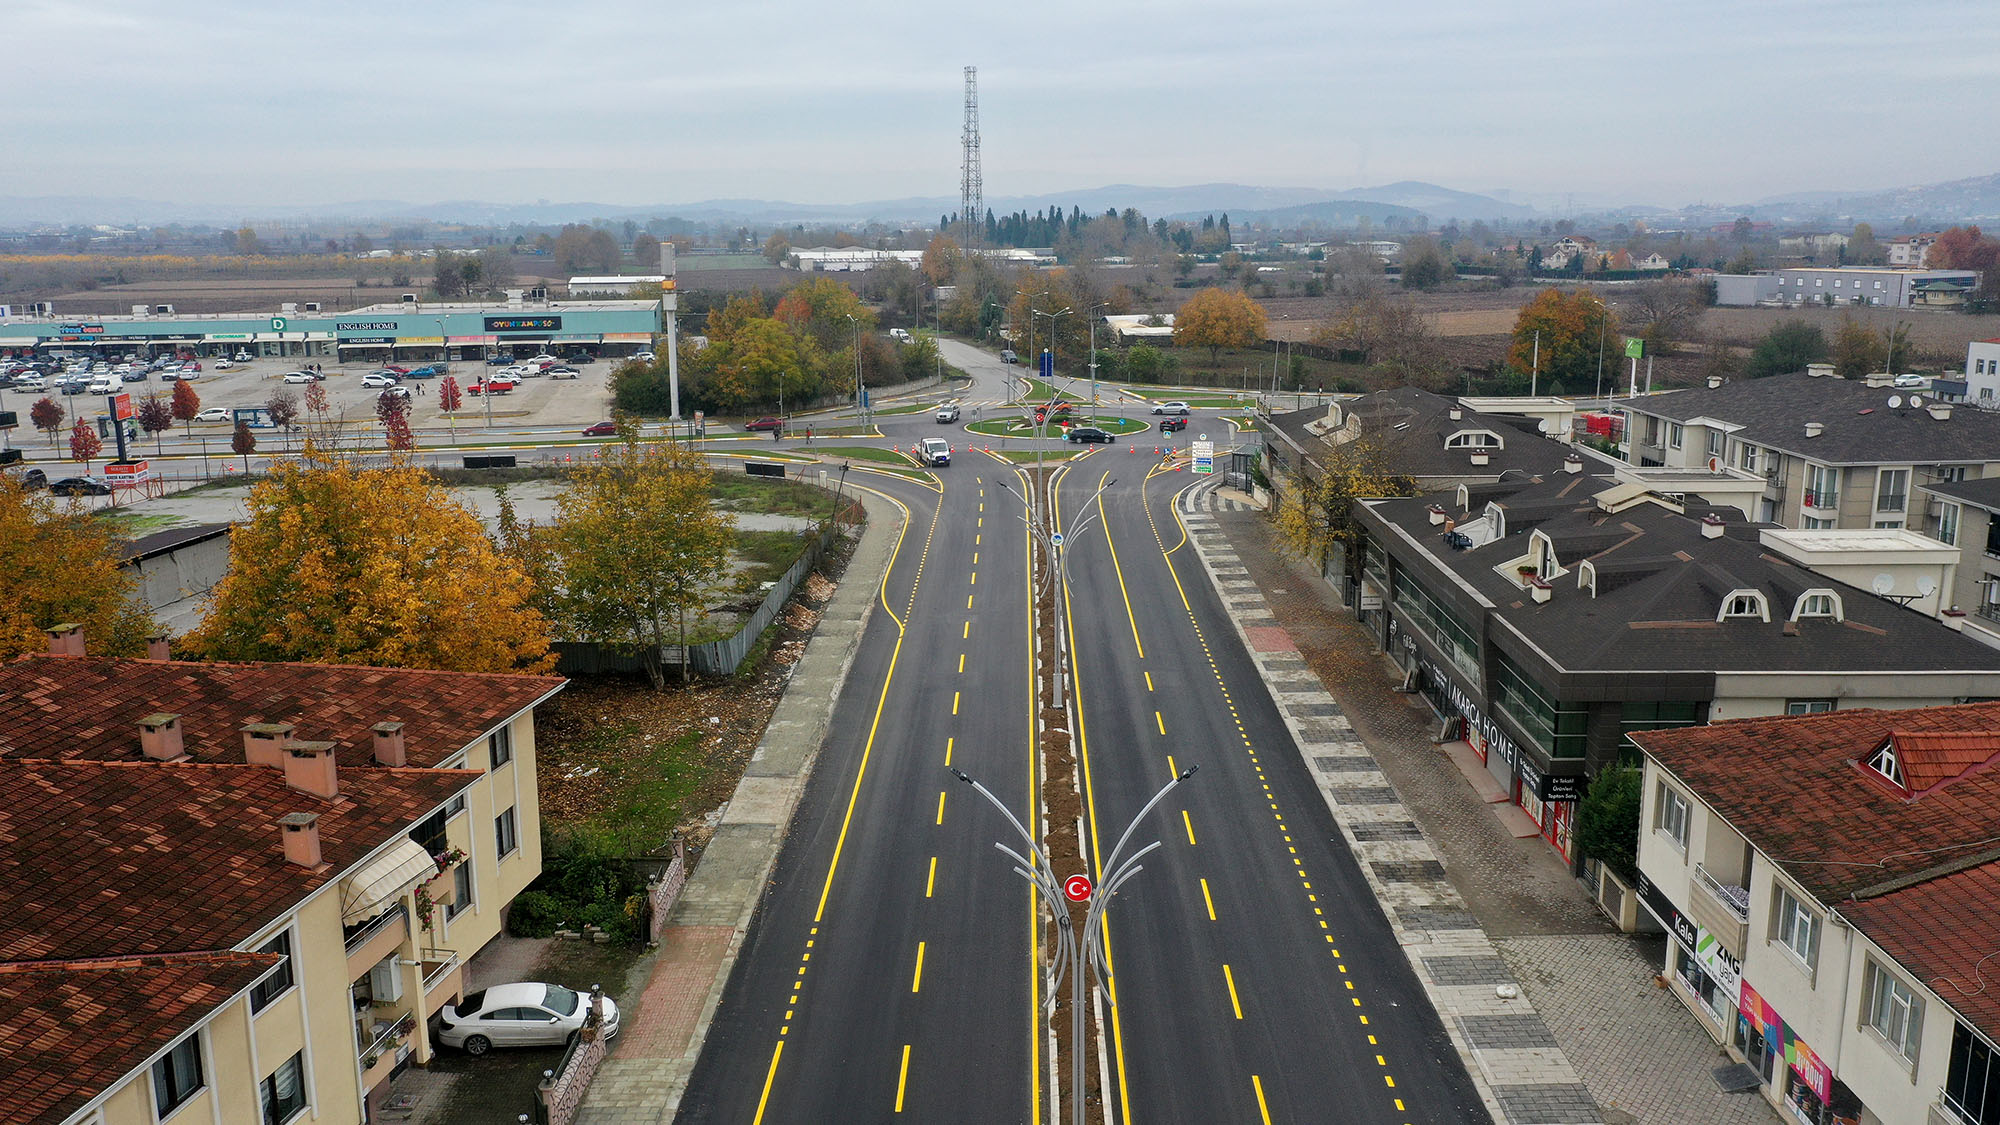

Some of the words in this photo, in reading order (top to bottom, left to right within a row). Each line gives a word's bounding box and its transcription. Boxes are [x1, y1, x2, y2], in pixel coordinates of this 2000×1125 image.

[373, 322, 396, 330] HOME
[1451, 685, 1480, 730] AKARCA
[1483, 716, 1513, 765] HOME
[1674, 913, 1694, 945] Kale
